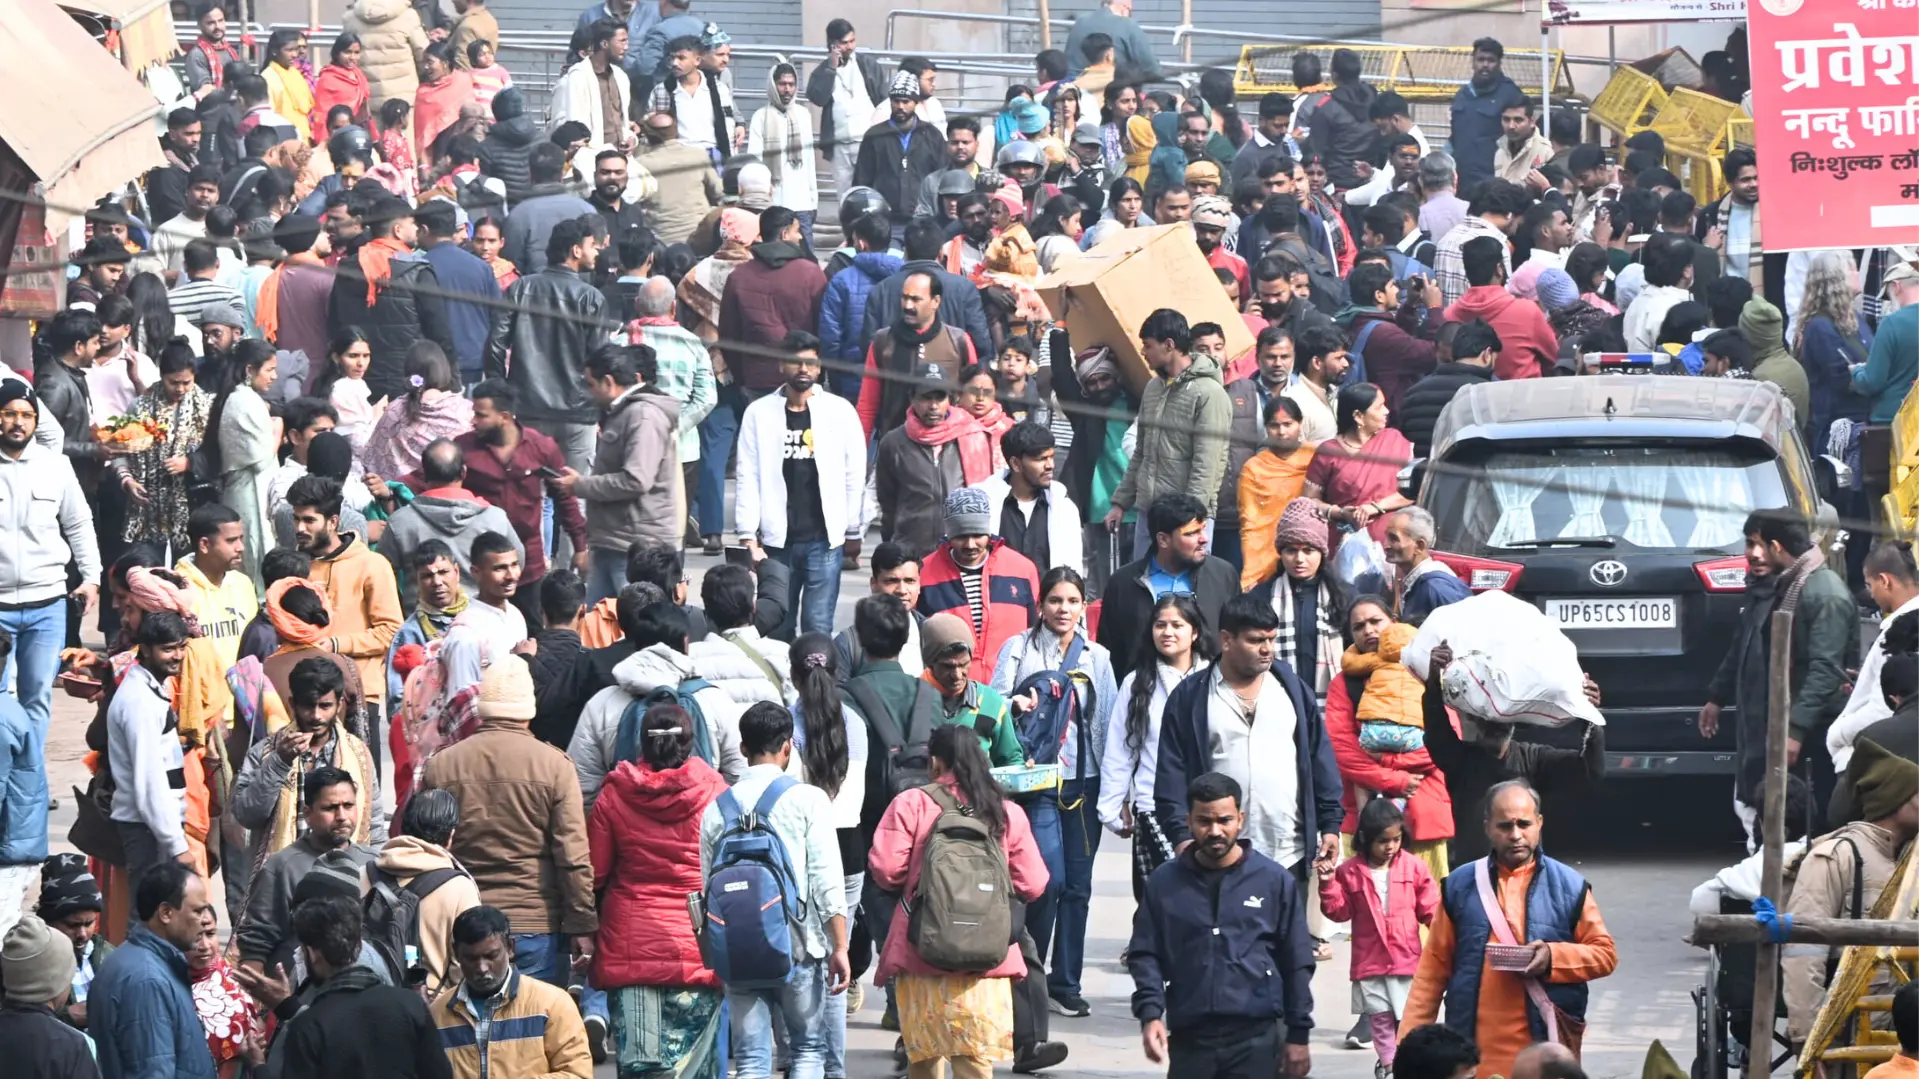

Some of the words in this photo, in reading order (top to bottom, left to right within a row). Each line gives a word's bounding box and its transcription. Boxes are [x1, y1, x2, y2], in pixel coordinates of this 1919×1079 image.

[1710, 2, 1735, 11] Shri
[1781, 107, 1855, 149] नन्दू
[1790, 151, 1885, 180] निःशुल्क
[1559, 603, 1671, 623] UP65CS1008
